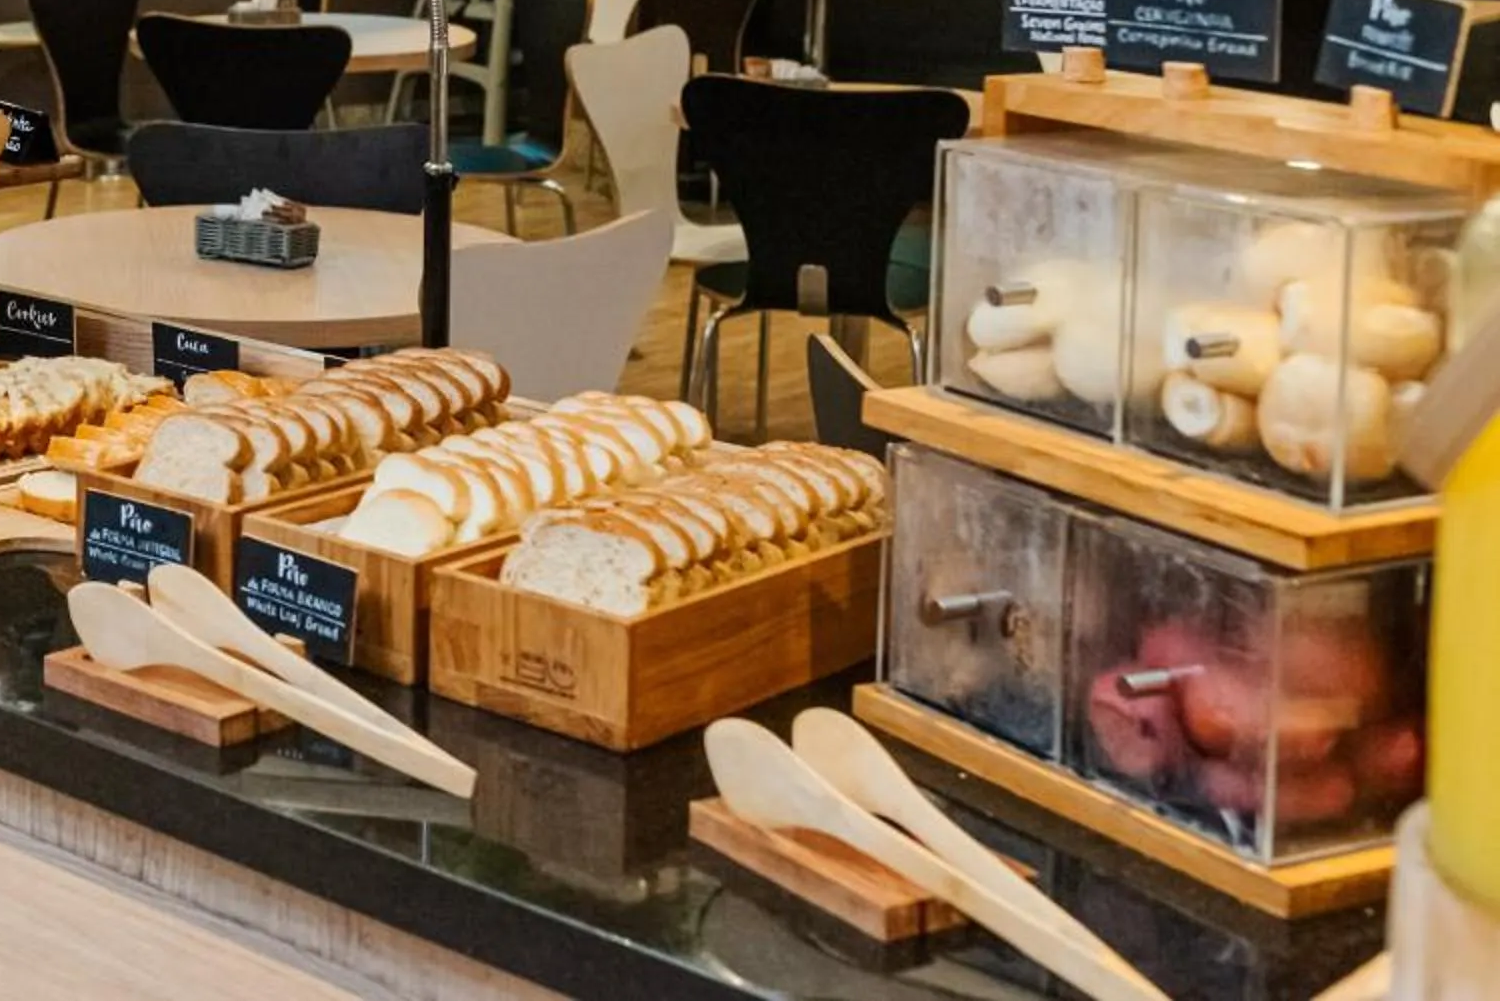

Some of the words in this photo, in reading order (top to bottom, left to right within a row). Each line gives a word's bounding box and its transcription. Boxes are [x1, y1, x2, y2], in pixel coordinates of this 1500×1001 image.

[1021, 13, 1061, 32] Seven
[7, 300, 58, 330] Cookies
[120, 502, 153, 534] Pão
[277, 551, 309, 587] Pão
[297, 589, 343, 618] BRANCO
[304, 615, 340, 642] Bread
